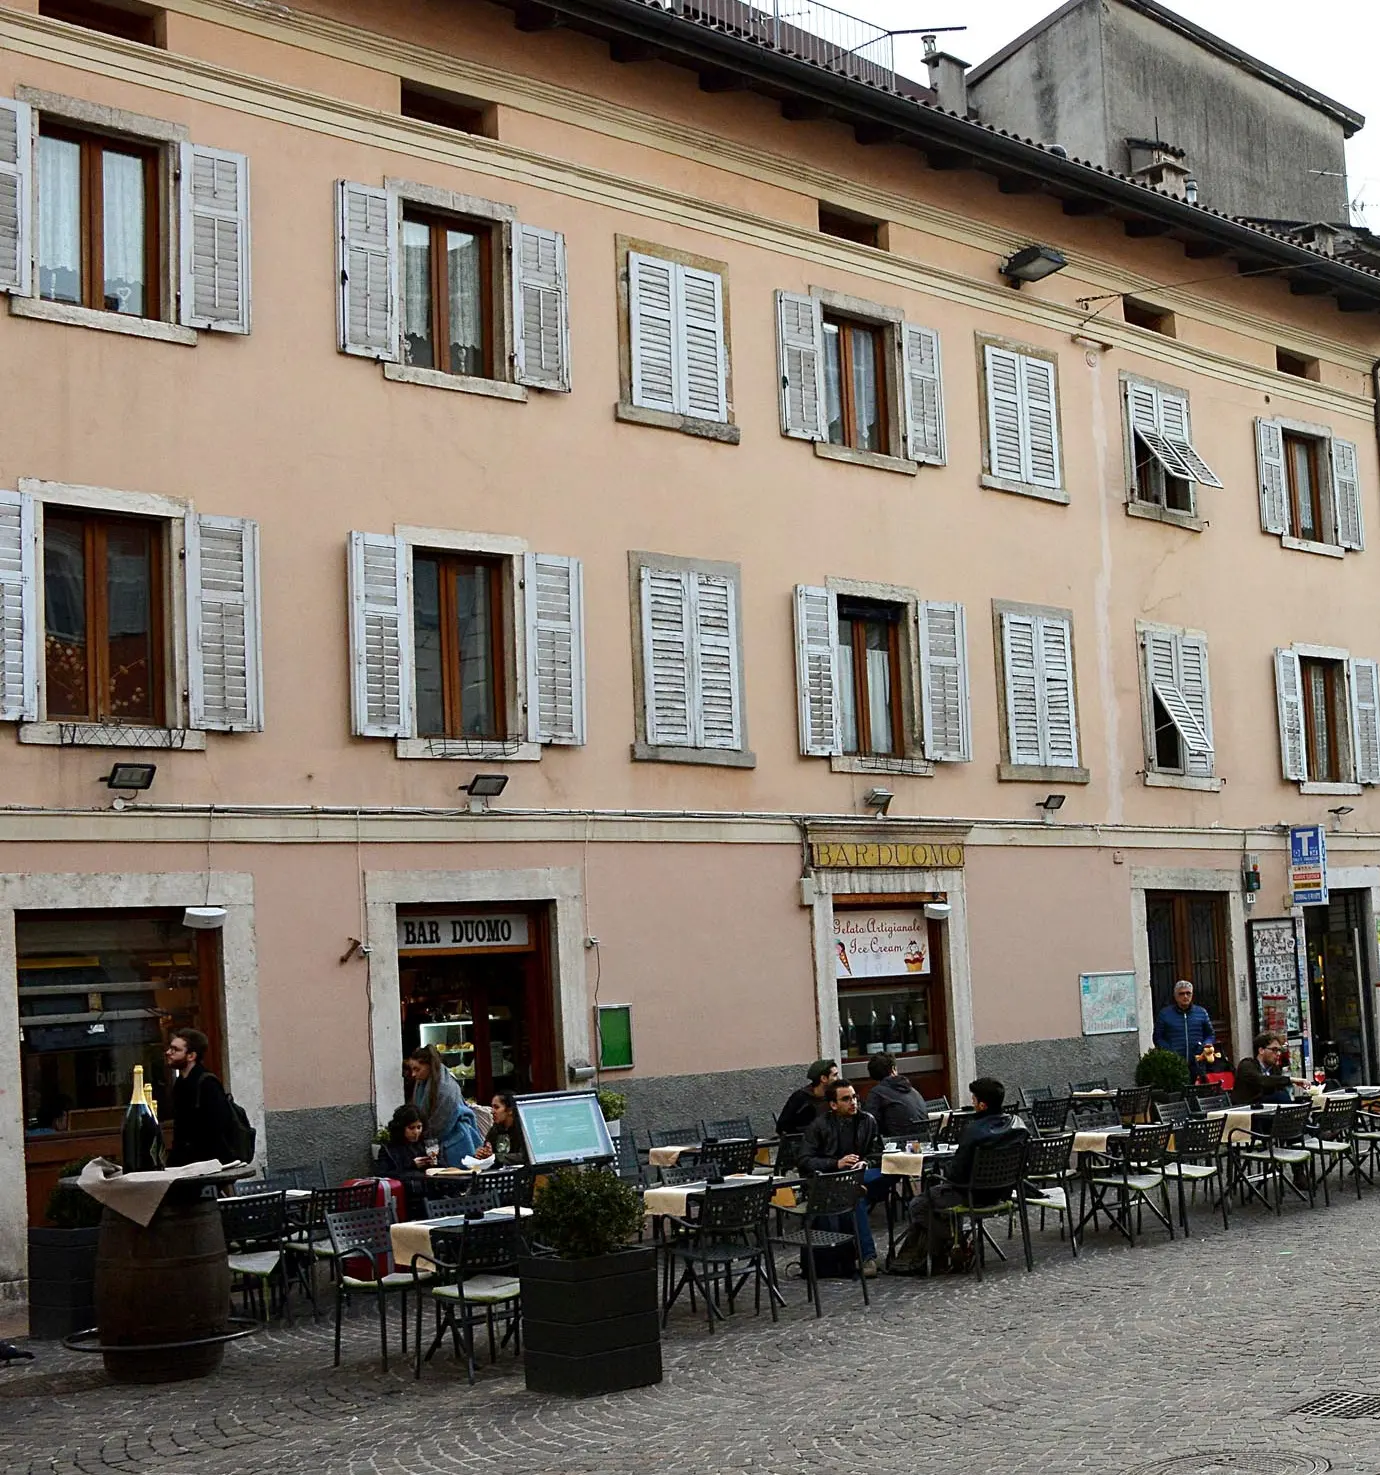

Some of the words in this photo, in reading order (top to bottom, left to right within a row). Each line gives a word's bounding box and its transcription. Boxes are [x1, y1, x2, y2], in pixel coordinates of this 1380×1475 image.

[816, 844, 868, 866] BAR
[877, 844, 962, 866] DUOMO
[1295, 831, 1314, 857] T
[404, 920, 441, 945] BAR
[450, 919, 512, 944] DUOMO
[833, 918, 866, 935] Gelato
[866, 917, 923, 939] Artigianale
[849, 938, 869, 955] Ice
[870, 936, 905, 954] Cream
